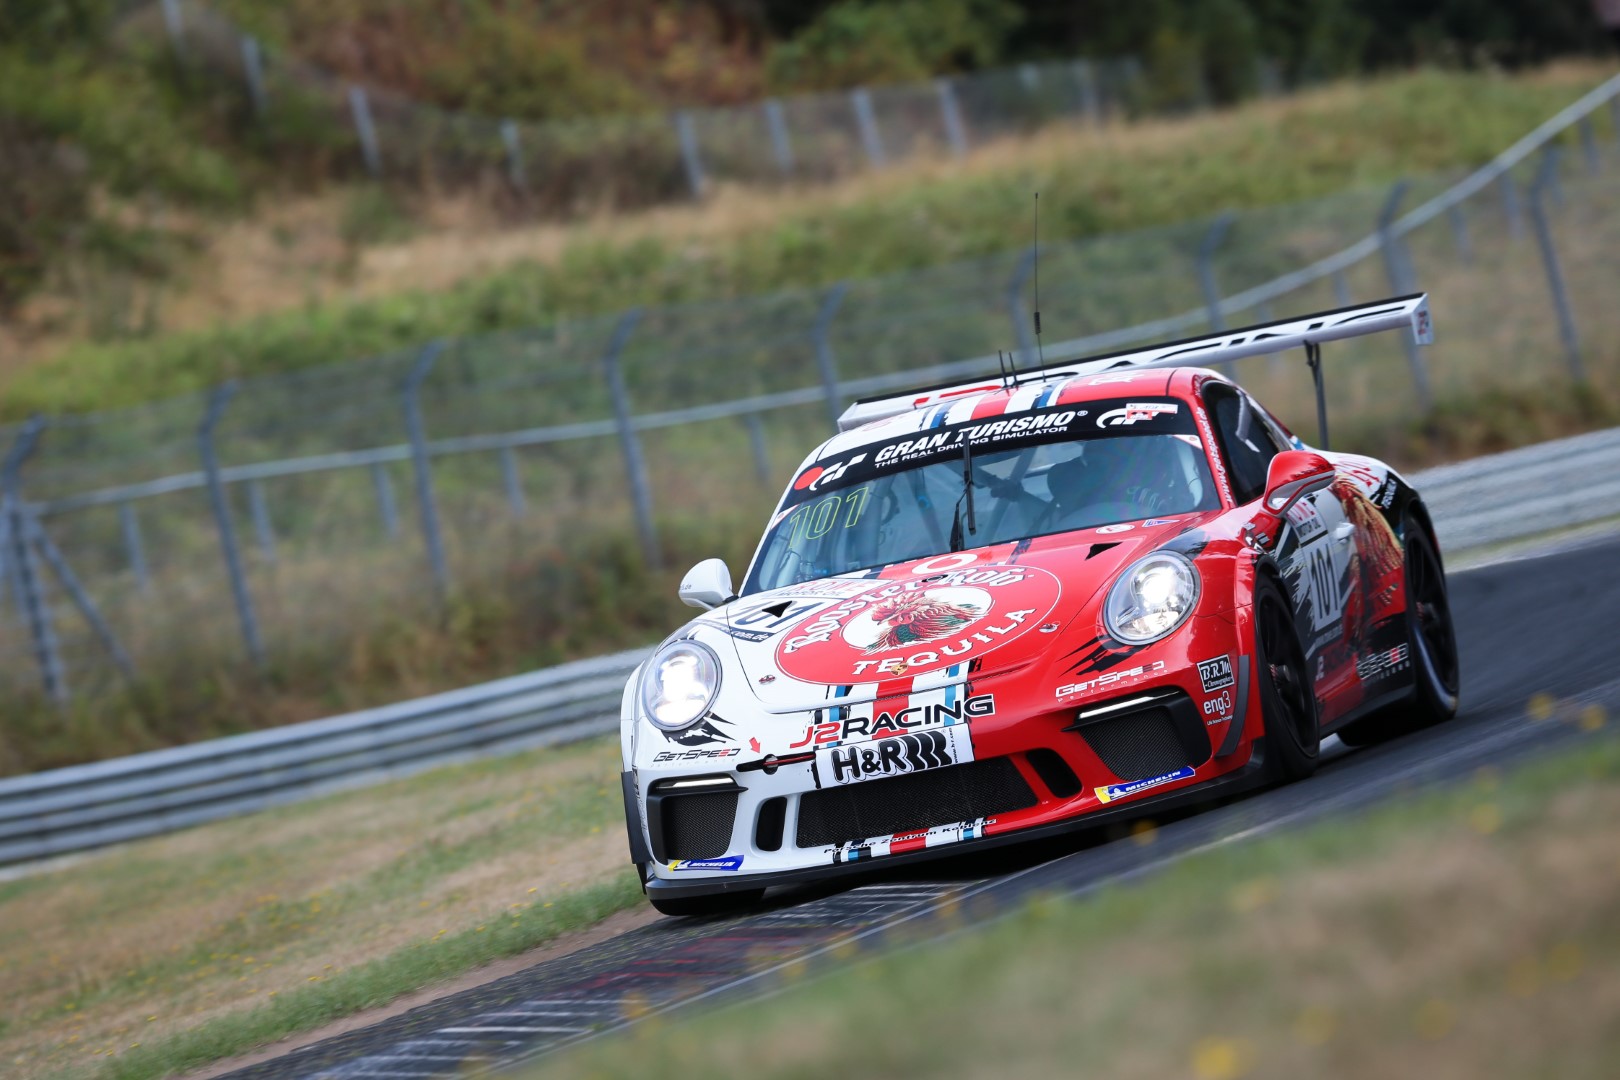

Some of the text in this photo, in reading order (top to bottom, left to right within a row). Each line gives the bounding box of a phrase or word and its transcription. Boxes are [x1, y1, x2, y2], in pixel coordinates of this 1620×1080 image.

[874, 426, 1068, 468] THE REAL DRIVNG SIMULATOR
[874, 431, 952, 464] GRAN
[788, 486, 869, 549] 101
[1310, 542, 1342, 620] 101
[852, 607, 1036, 676] TEQUILA
[1203, 690, 1231, 716] eng3
[1125, 769, 1181, 792] MICHELIN
[881, 830, 937, 845] Zentrum
